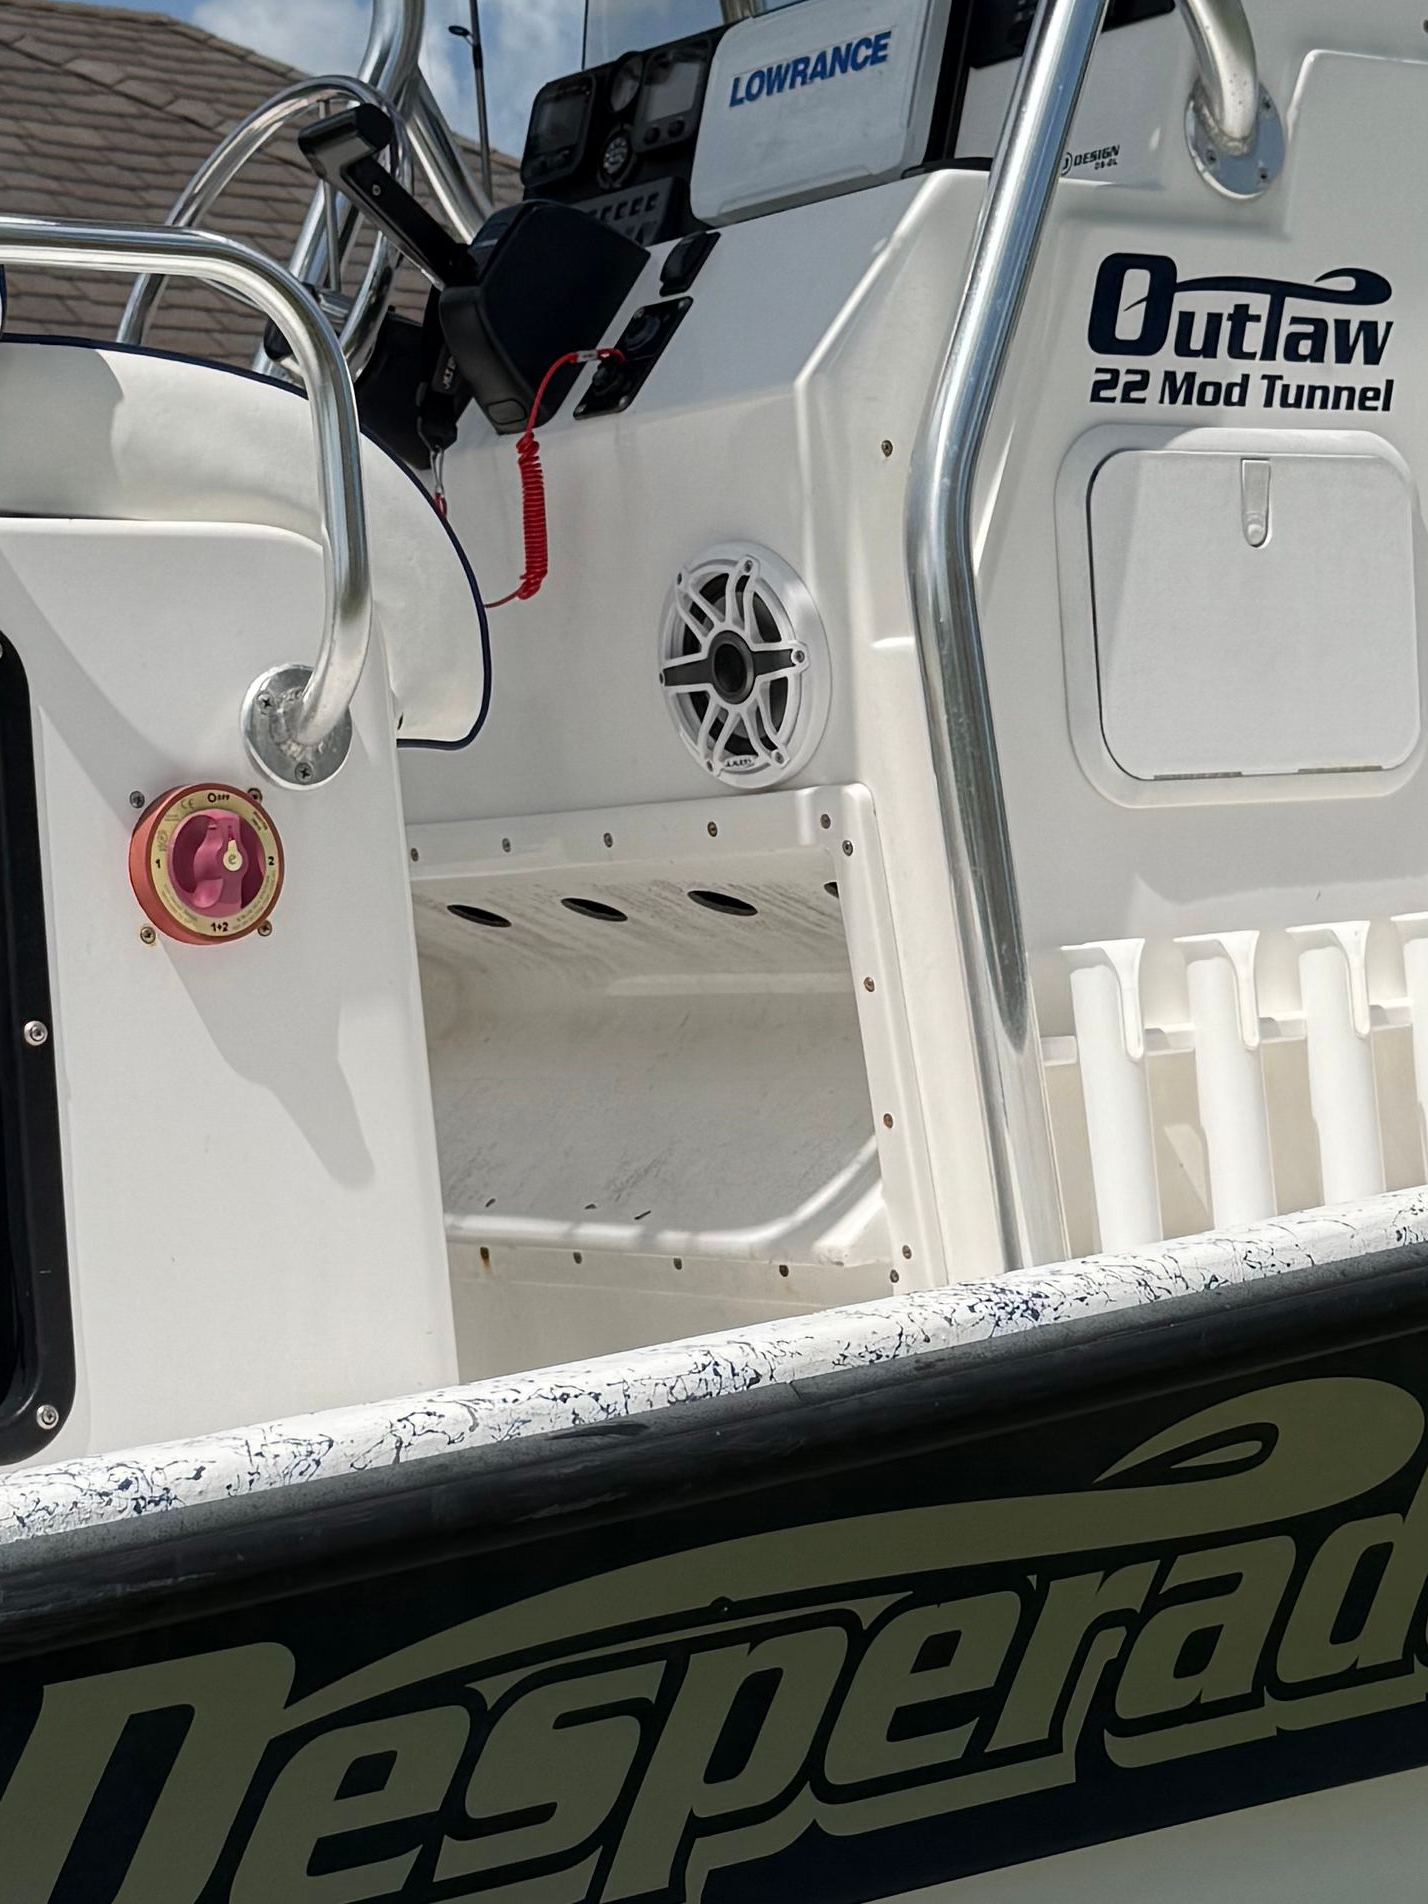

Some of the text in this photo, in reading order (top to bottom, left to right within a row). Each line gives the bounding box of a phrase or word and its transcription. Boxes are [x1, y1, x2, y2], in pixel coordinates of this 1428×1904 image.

[729, 30, 893, 109] LOWRANCE
[1073, 144, 1120, 166] DESIGN
[1087, 252, 1395, 366] Outlaw
[1089, 367, 1395, 413] 22 Mod Tunnel
[155, 859, 161, 869] 1
[268, 856, 275, 866] 2
[211, 922, 229, 932] 1+2
